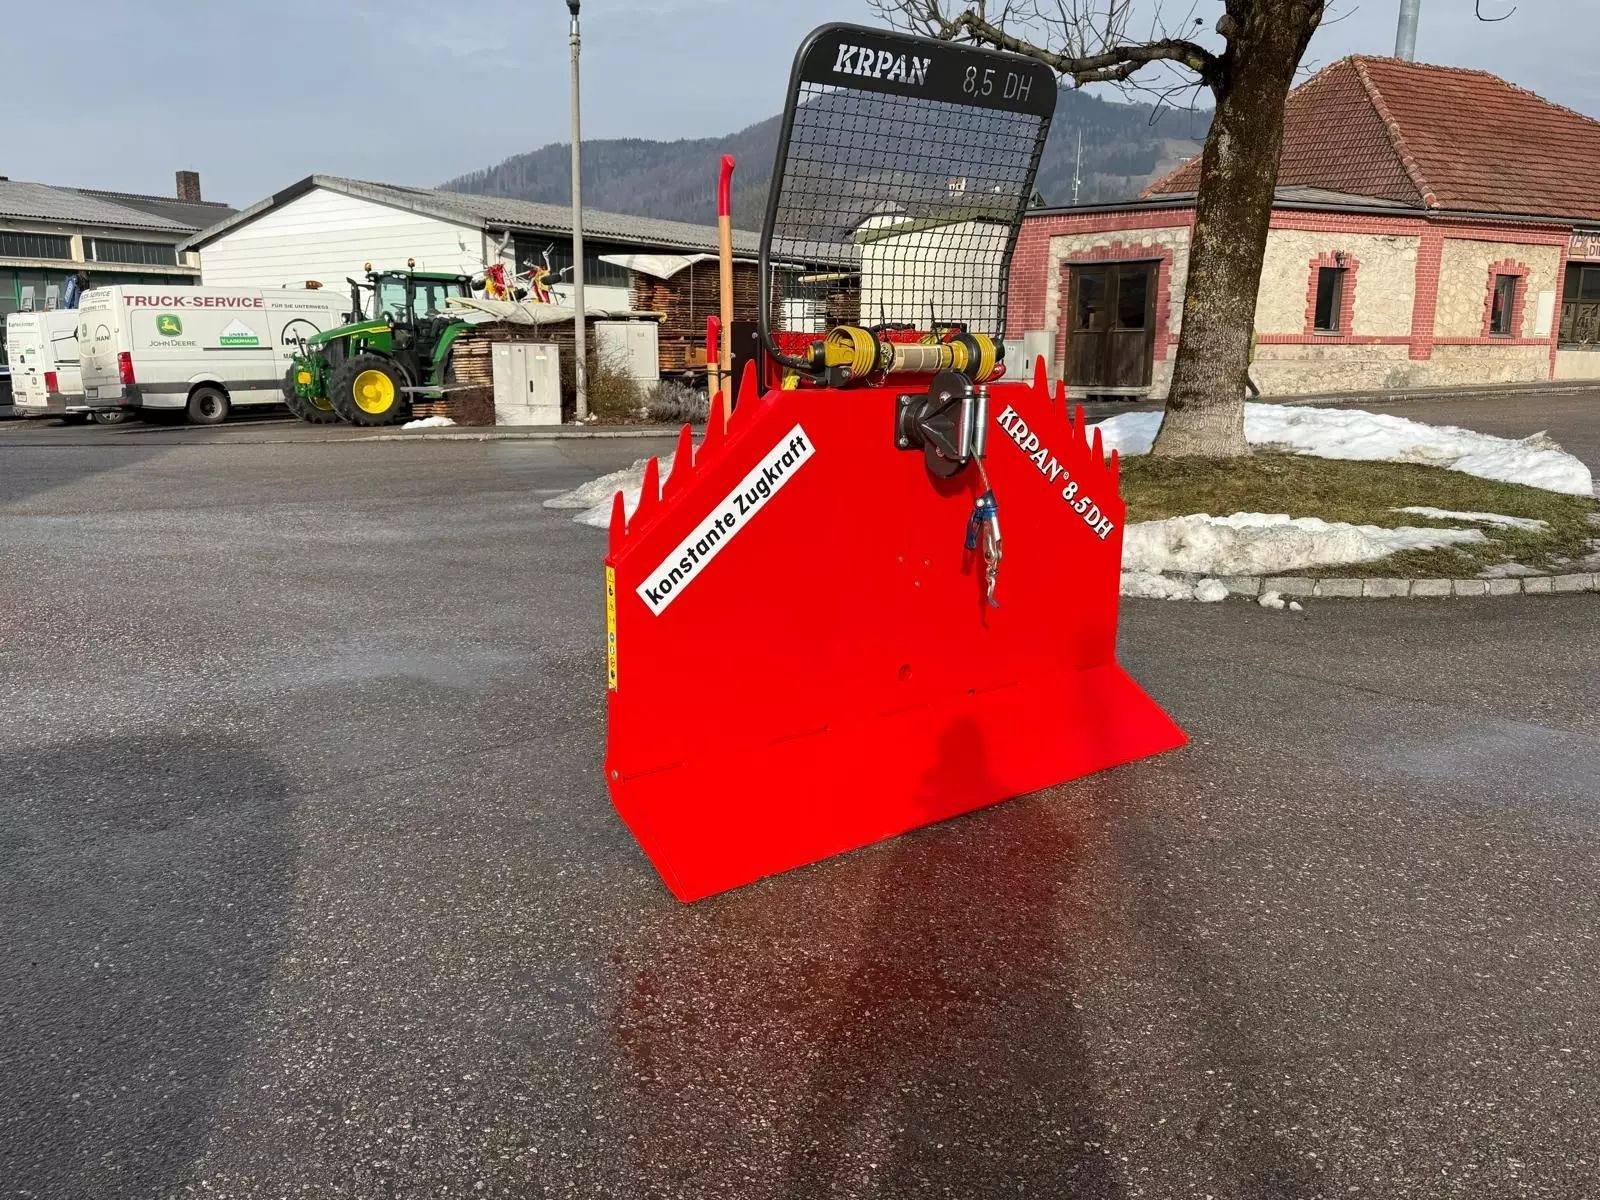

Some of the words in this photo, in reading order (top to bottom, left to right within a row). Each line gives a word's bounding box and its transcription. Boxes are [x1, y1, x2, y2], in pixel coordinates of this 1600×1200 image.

[833, 44, 931, 86] KRPAN
[963, 66, 996, 98] 8,5
[1003, 72, 1033, 102] DH
[123, 295, 263, 308] TRUCK-SERVICE
[645, 512, 736, 605] konstante
[733, 436, 807, 516] Zugkraft
